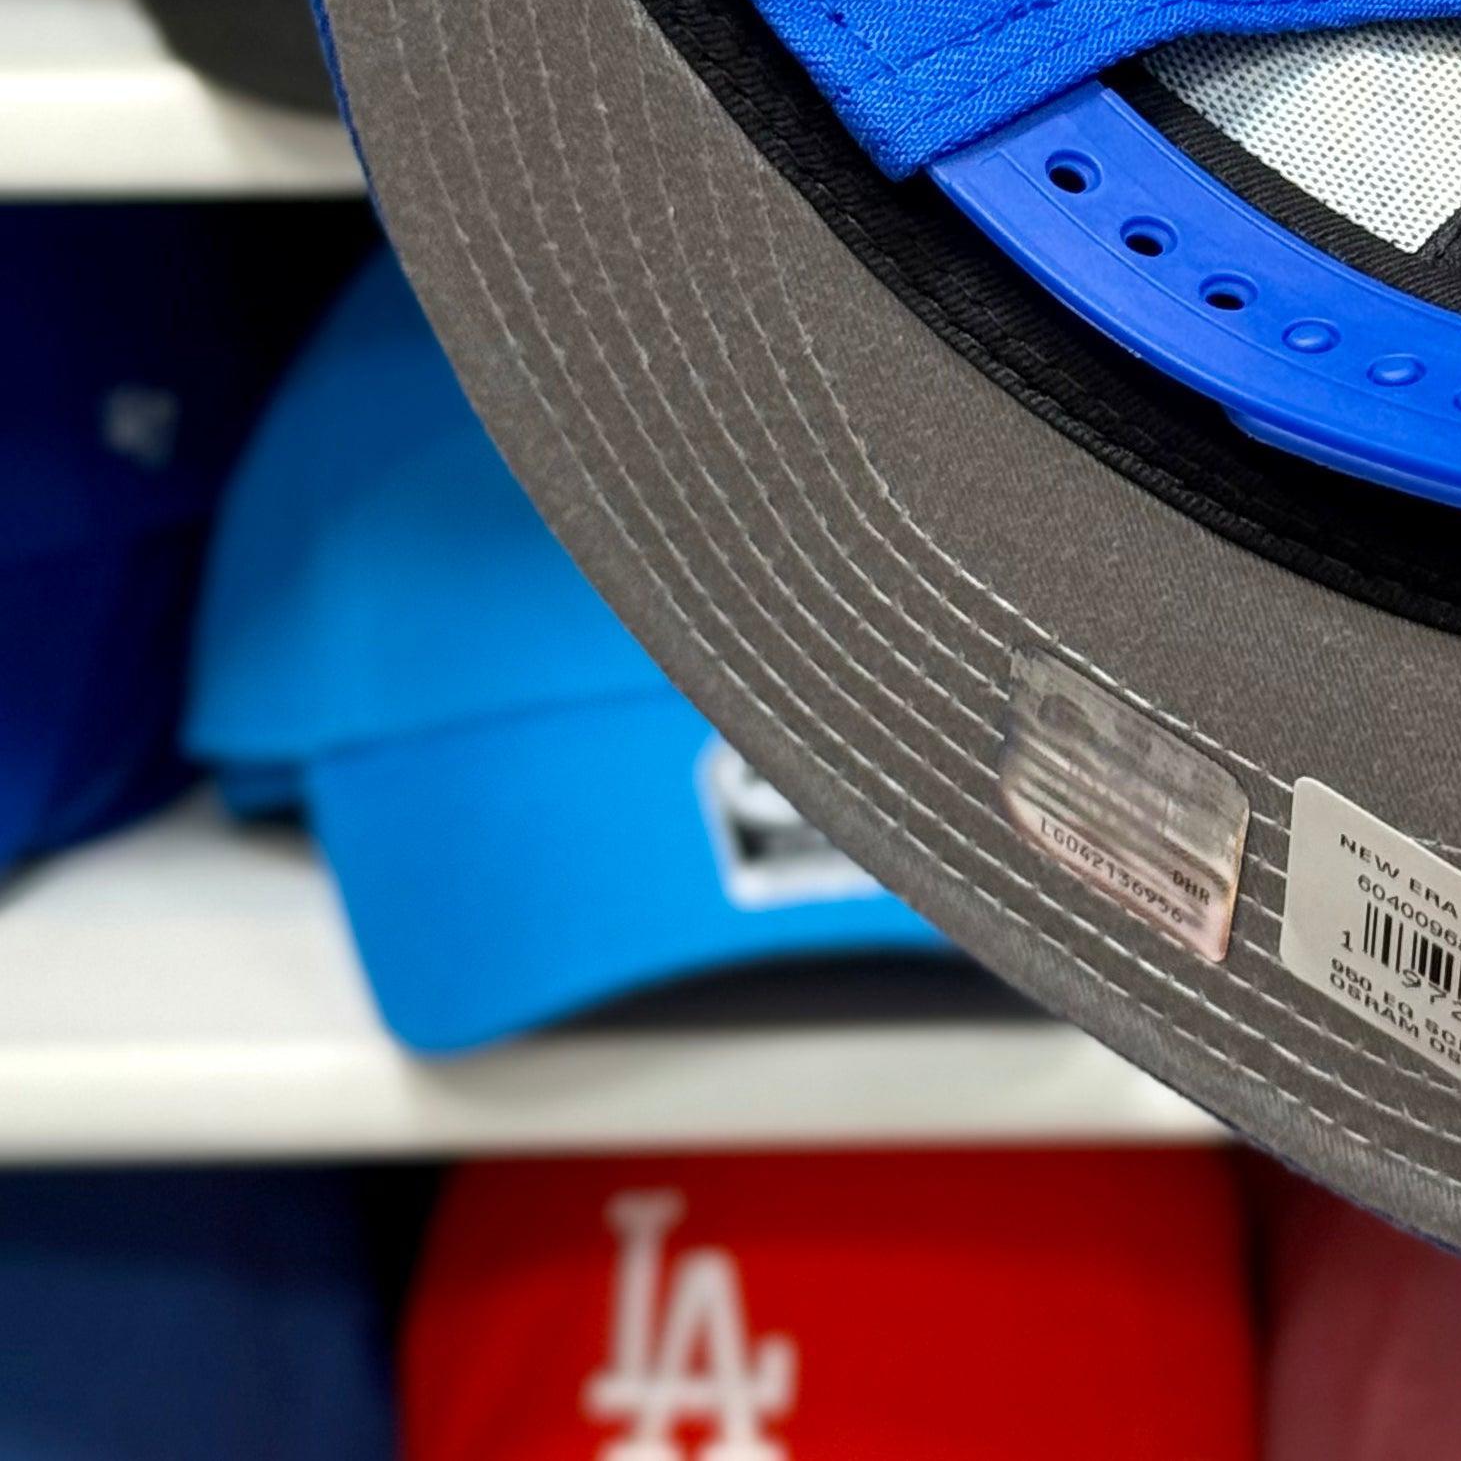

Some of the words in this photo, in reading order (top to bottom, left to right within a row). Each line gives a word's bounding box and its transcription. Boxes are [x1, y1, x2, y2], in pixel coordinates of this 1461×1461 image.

[1340, 833, 1400, 879] NEW
[1410, 878, 1458, 920] ERA
[1341, 930, 1353, 953] 1
[577, 1187, 799, 1461] LA
